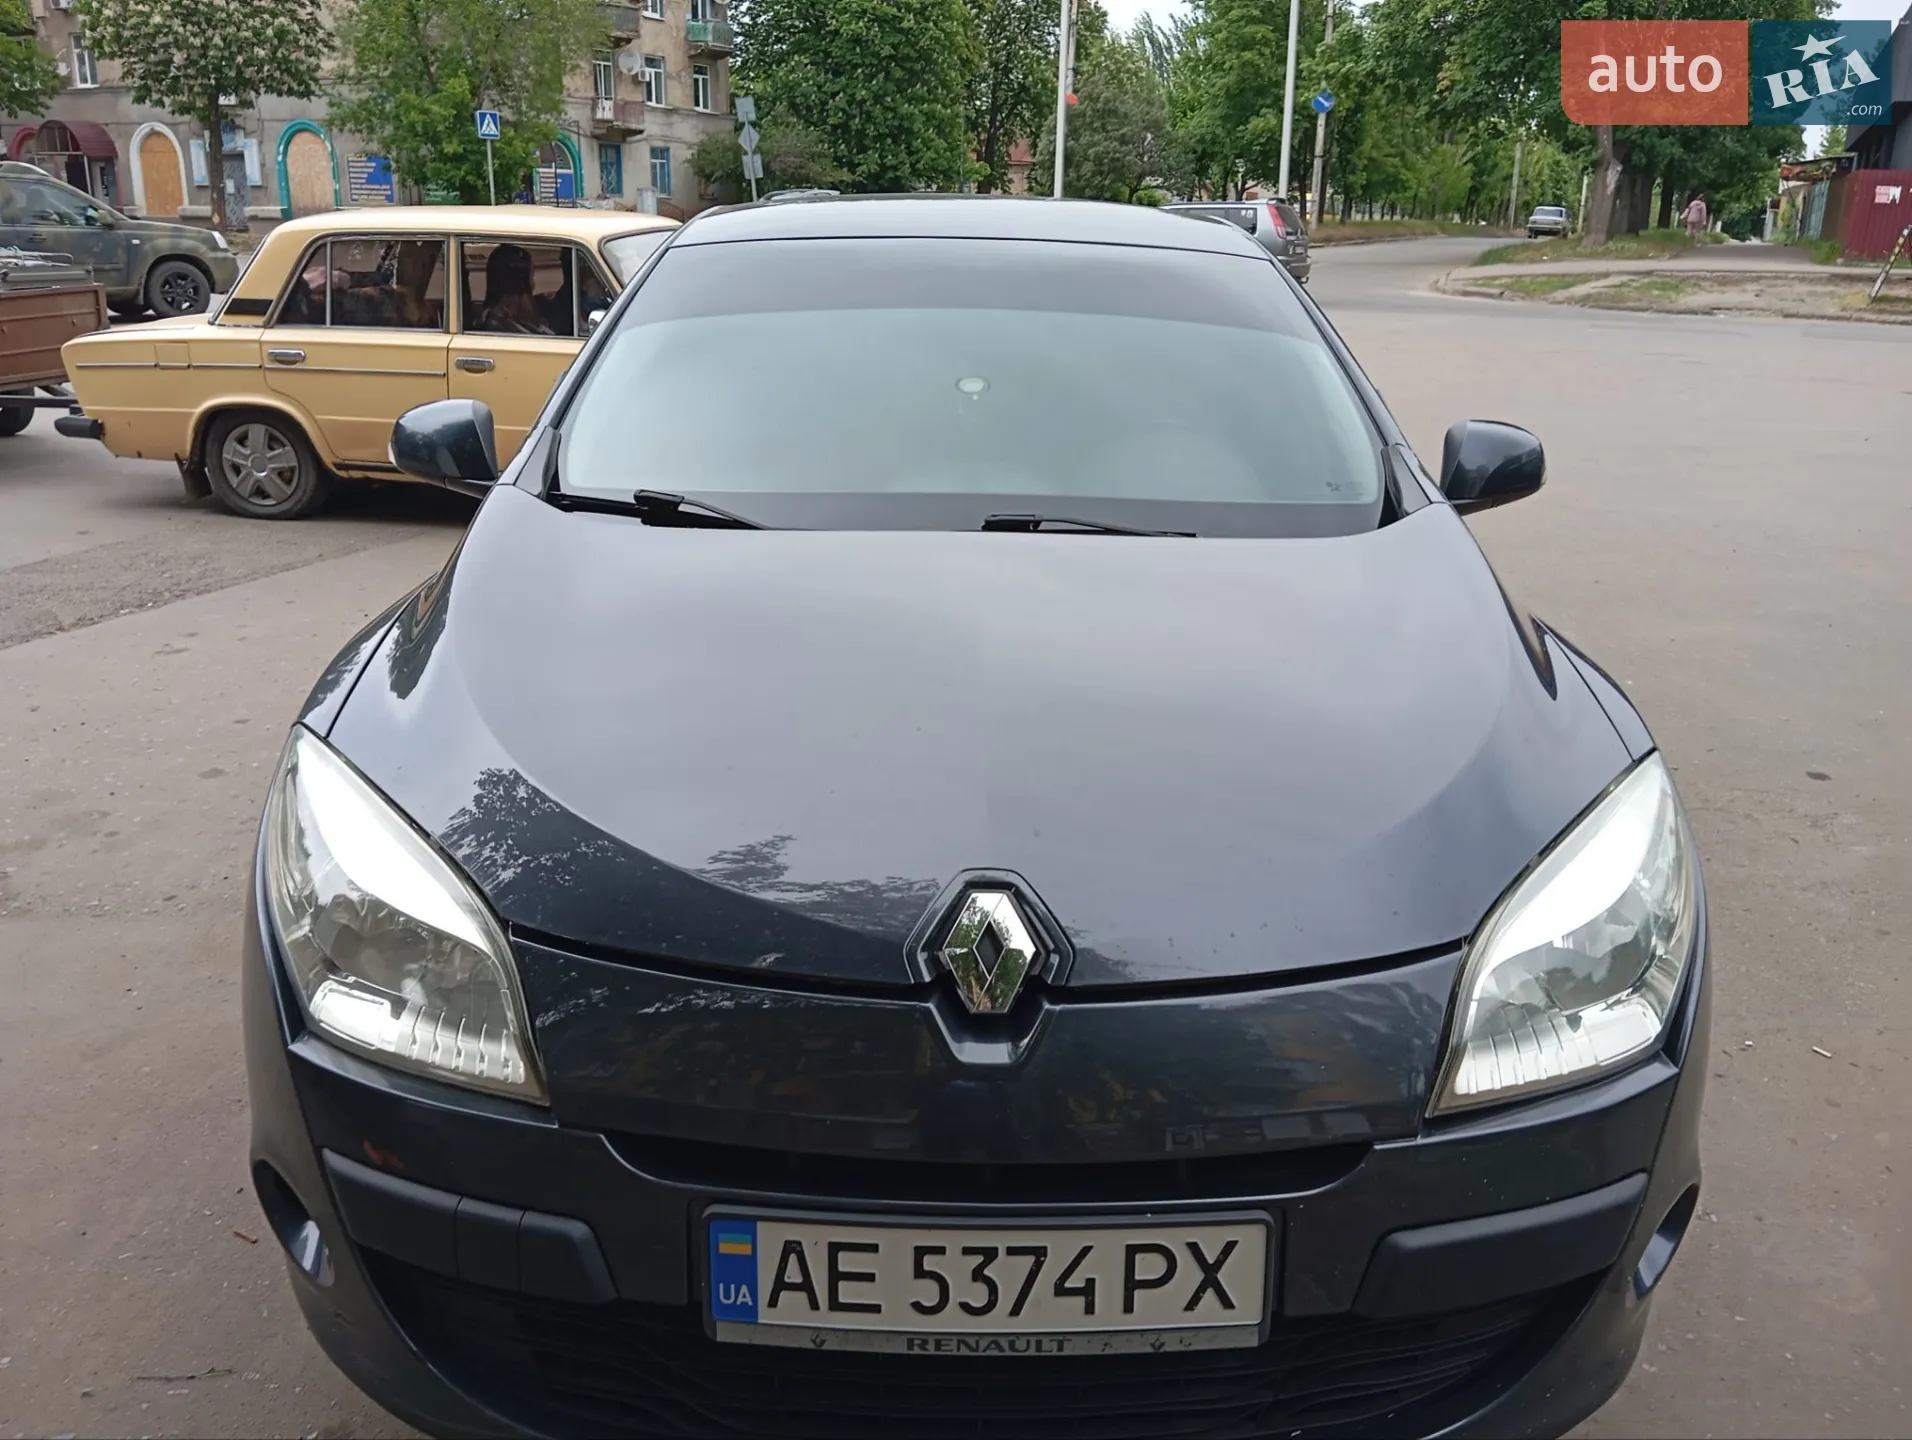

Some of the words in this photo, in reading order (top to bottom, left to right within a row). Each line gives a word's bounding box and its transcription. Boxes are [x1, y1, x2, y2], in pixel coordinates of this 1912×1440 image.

[767, 1239, 882, 1315] AE
[909, 1245, 1097, 1317] 5374
[1122, 1240, 1240, 1314] PX
[718, 1282, 753, 1306] UA
[906, 1336, 1072, 1353] RENAULT
